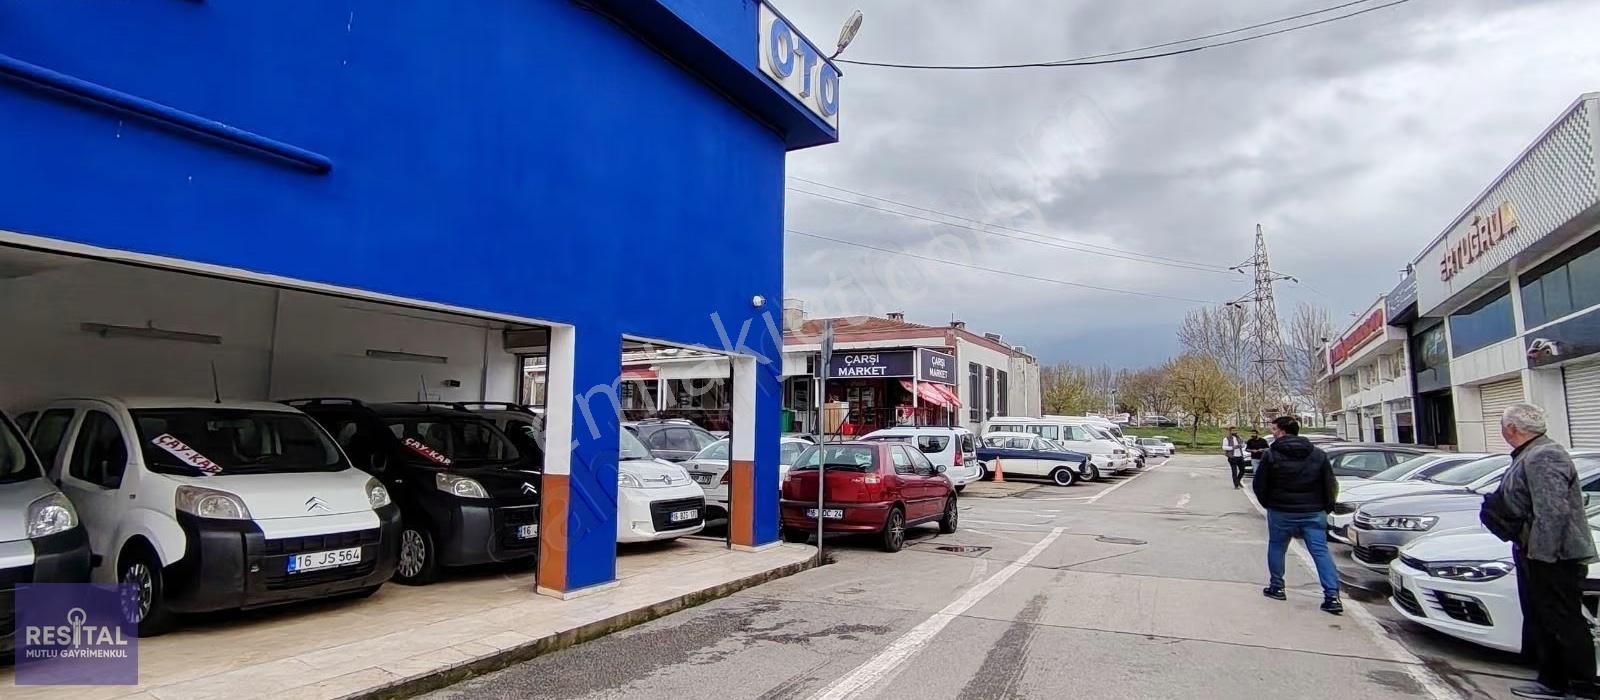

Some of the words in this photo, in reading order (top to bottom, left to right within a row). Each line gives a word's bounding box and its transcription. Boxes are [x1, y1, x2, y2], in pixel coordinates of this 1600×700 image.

[765, 16, 839, 117] OTO
[838, 366, 887, 376] MARKET
[929, 367, 948, 379] MARKET
[523, 526, 531, 535] 16
[298, 556, 312, 568] 16
[318, 552, 336, 565] JS
[339, 550, 360, 562] 564
